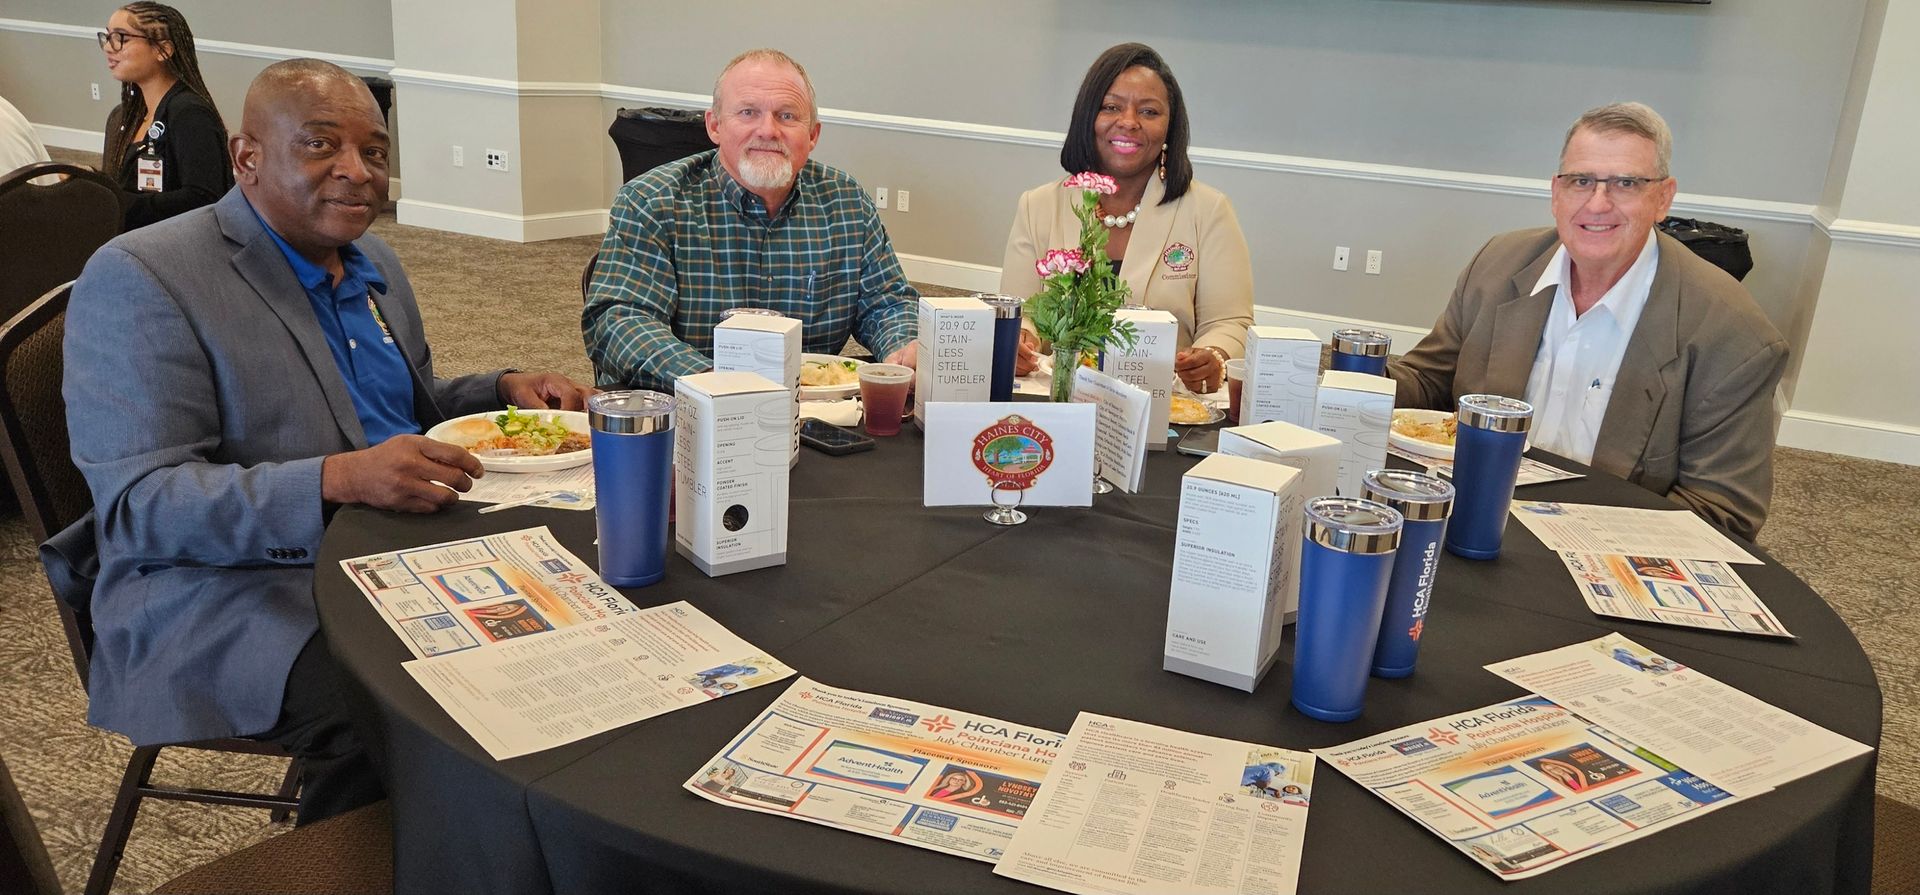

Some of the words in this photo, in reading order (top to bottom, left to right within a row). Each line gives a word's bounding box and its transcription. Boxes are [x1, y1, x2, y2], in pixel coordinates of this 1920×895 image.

[939, 321, 960, 331] 20.9
[962, 320, 976, 331] OZ
[939, 334, 972, 344] STAIN-
[1143, 335, 1158, 345] OZ
[938, 348, 964, 358] LESS
[937, 361, 969, 371] STEEL
[1117, 362, 1144, 371] LESS
[937, 374, 986, 384] TUMBLER
[676, 433, 691, 453] LESS
[977, 425, 1019, 447] HAINES
[1022, 427, 1049, 444] CITY
[676, 451, 696, 474] STEEL
[982, 465, 1003, 479] HEART
[1017, 464, 1046, 479] FLORIDA
[676, 469, 707, 498] TUMBLER
[1181, 541, 1205, 551] SUPERIOR
[1205, 547, 1236, 558] INSULATION
[1418, 541, 1437, 587] Florida
[582, 581, 608, 599] HCA
[1412, 588, 1427, 618] HCA
[834, 699, 863, 710] Florida
[1448, 716, 1489, 732] HCA
[1483, 704, 1537, 723] Florida
[1465, 721, 1521, 740] Poinciana
[1519, 711, 1567, 726] Hospital
[964, 720, 1009, 738] HCA
[1013, 730, 1063, 749] Flori
[1485, 730, 1527, 745] Chamber
[1524, 719, 1570, 734] Luncheon
[934, 735, 961, 748] July
[965, 740, 1021, 759] Chamber
[956, 731, 1030, 754] Poinciana
[1034, 747, 1058, 759] Ho
[912, 747, 954, 763] Placemat
[837, 756, 904, 774] AdventHealth
[997, 786, 1035, 798] NOVOTNY
[1002, 780, 1038, 793] LYNDSEY
